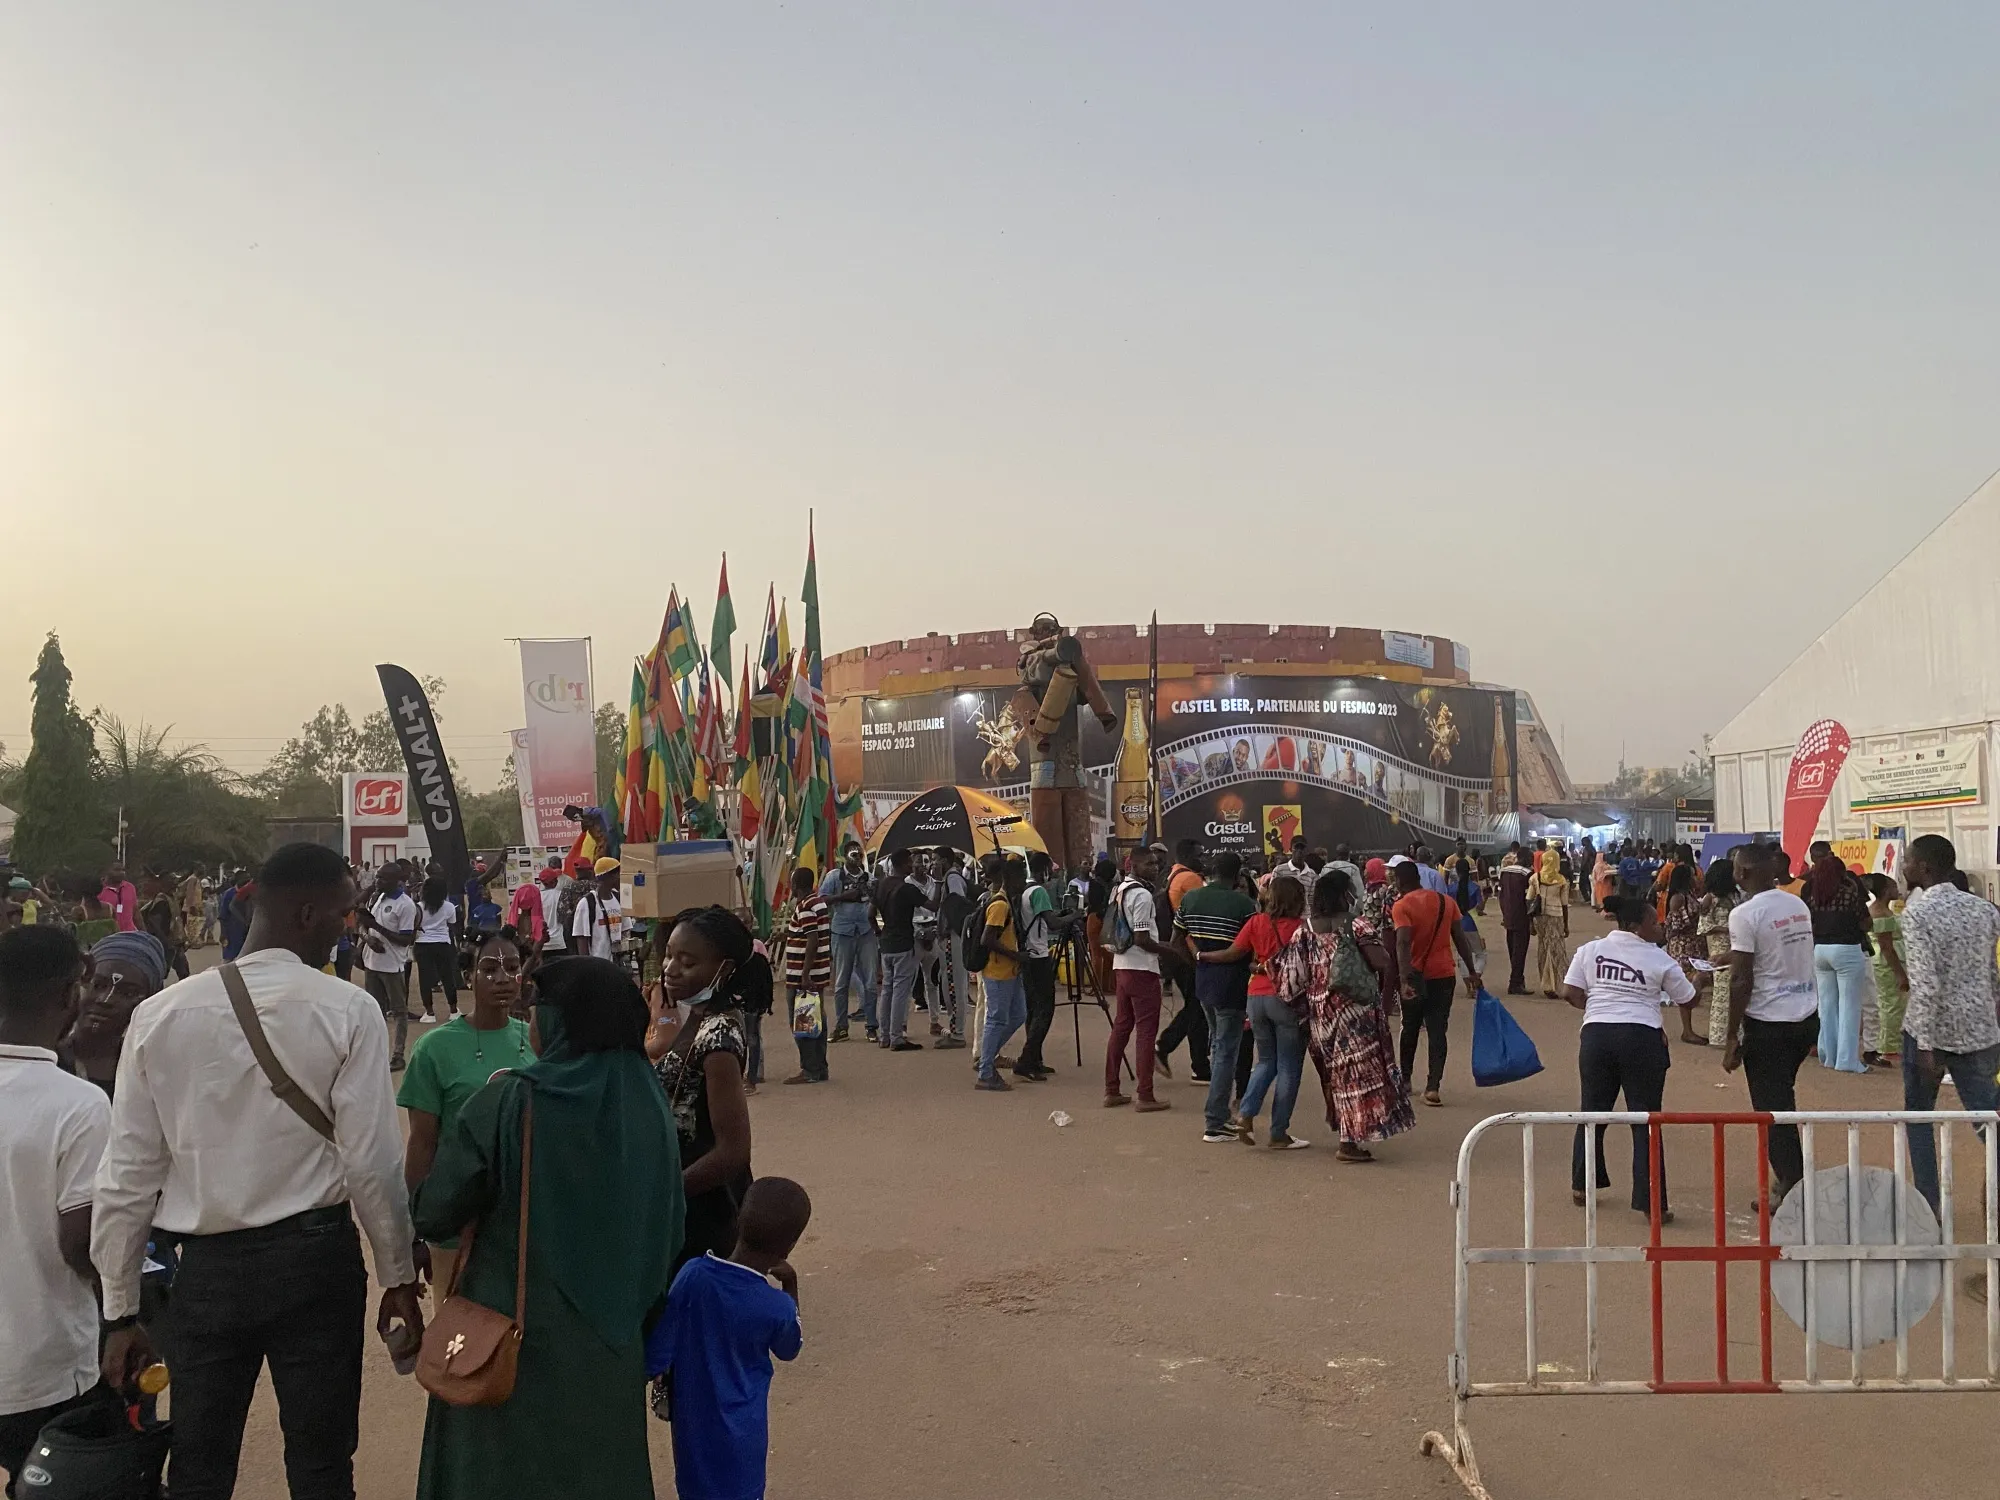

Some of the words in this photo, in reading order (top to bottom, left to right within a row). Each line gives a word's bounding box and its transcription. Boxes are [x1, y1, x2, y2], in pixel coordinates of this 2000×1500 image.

[1171, 699, 1217, 713] CASTEL
[1221, 698, 1254, 715] BEER,
[1257, 699, 1320, 713] PARTENAIRE
[1323, 700, 1337, 713] DU
[1340, 700, 1376, 714] FESPACO
[1377, 703, 1398, 716] 2023
[874, 722, 896, 736] BEER,
[897, 717, 945, 733] PARTENAIRE
[862, 738, 892, 751] FESPACO
[894, 736, 915, 750] 2023
[397, 694, 453, 831] CANAL+
[360, 784, 401, 810] bf1
[918, 804, 931, 812] Le
[1119, 803, 1148, 814] Caste
[1204, 821, 1256, 836] Castel
[1840, 841, 1867, 860] lonab
